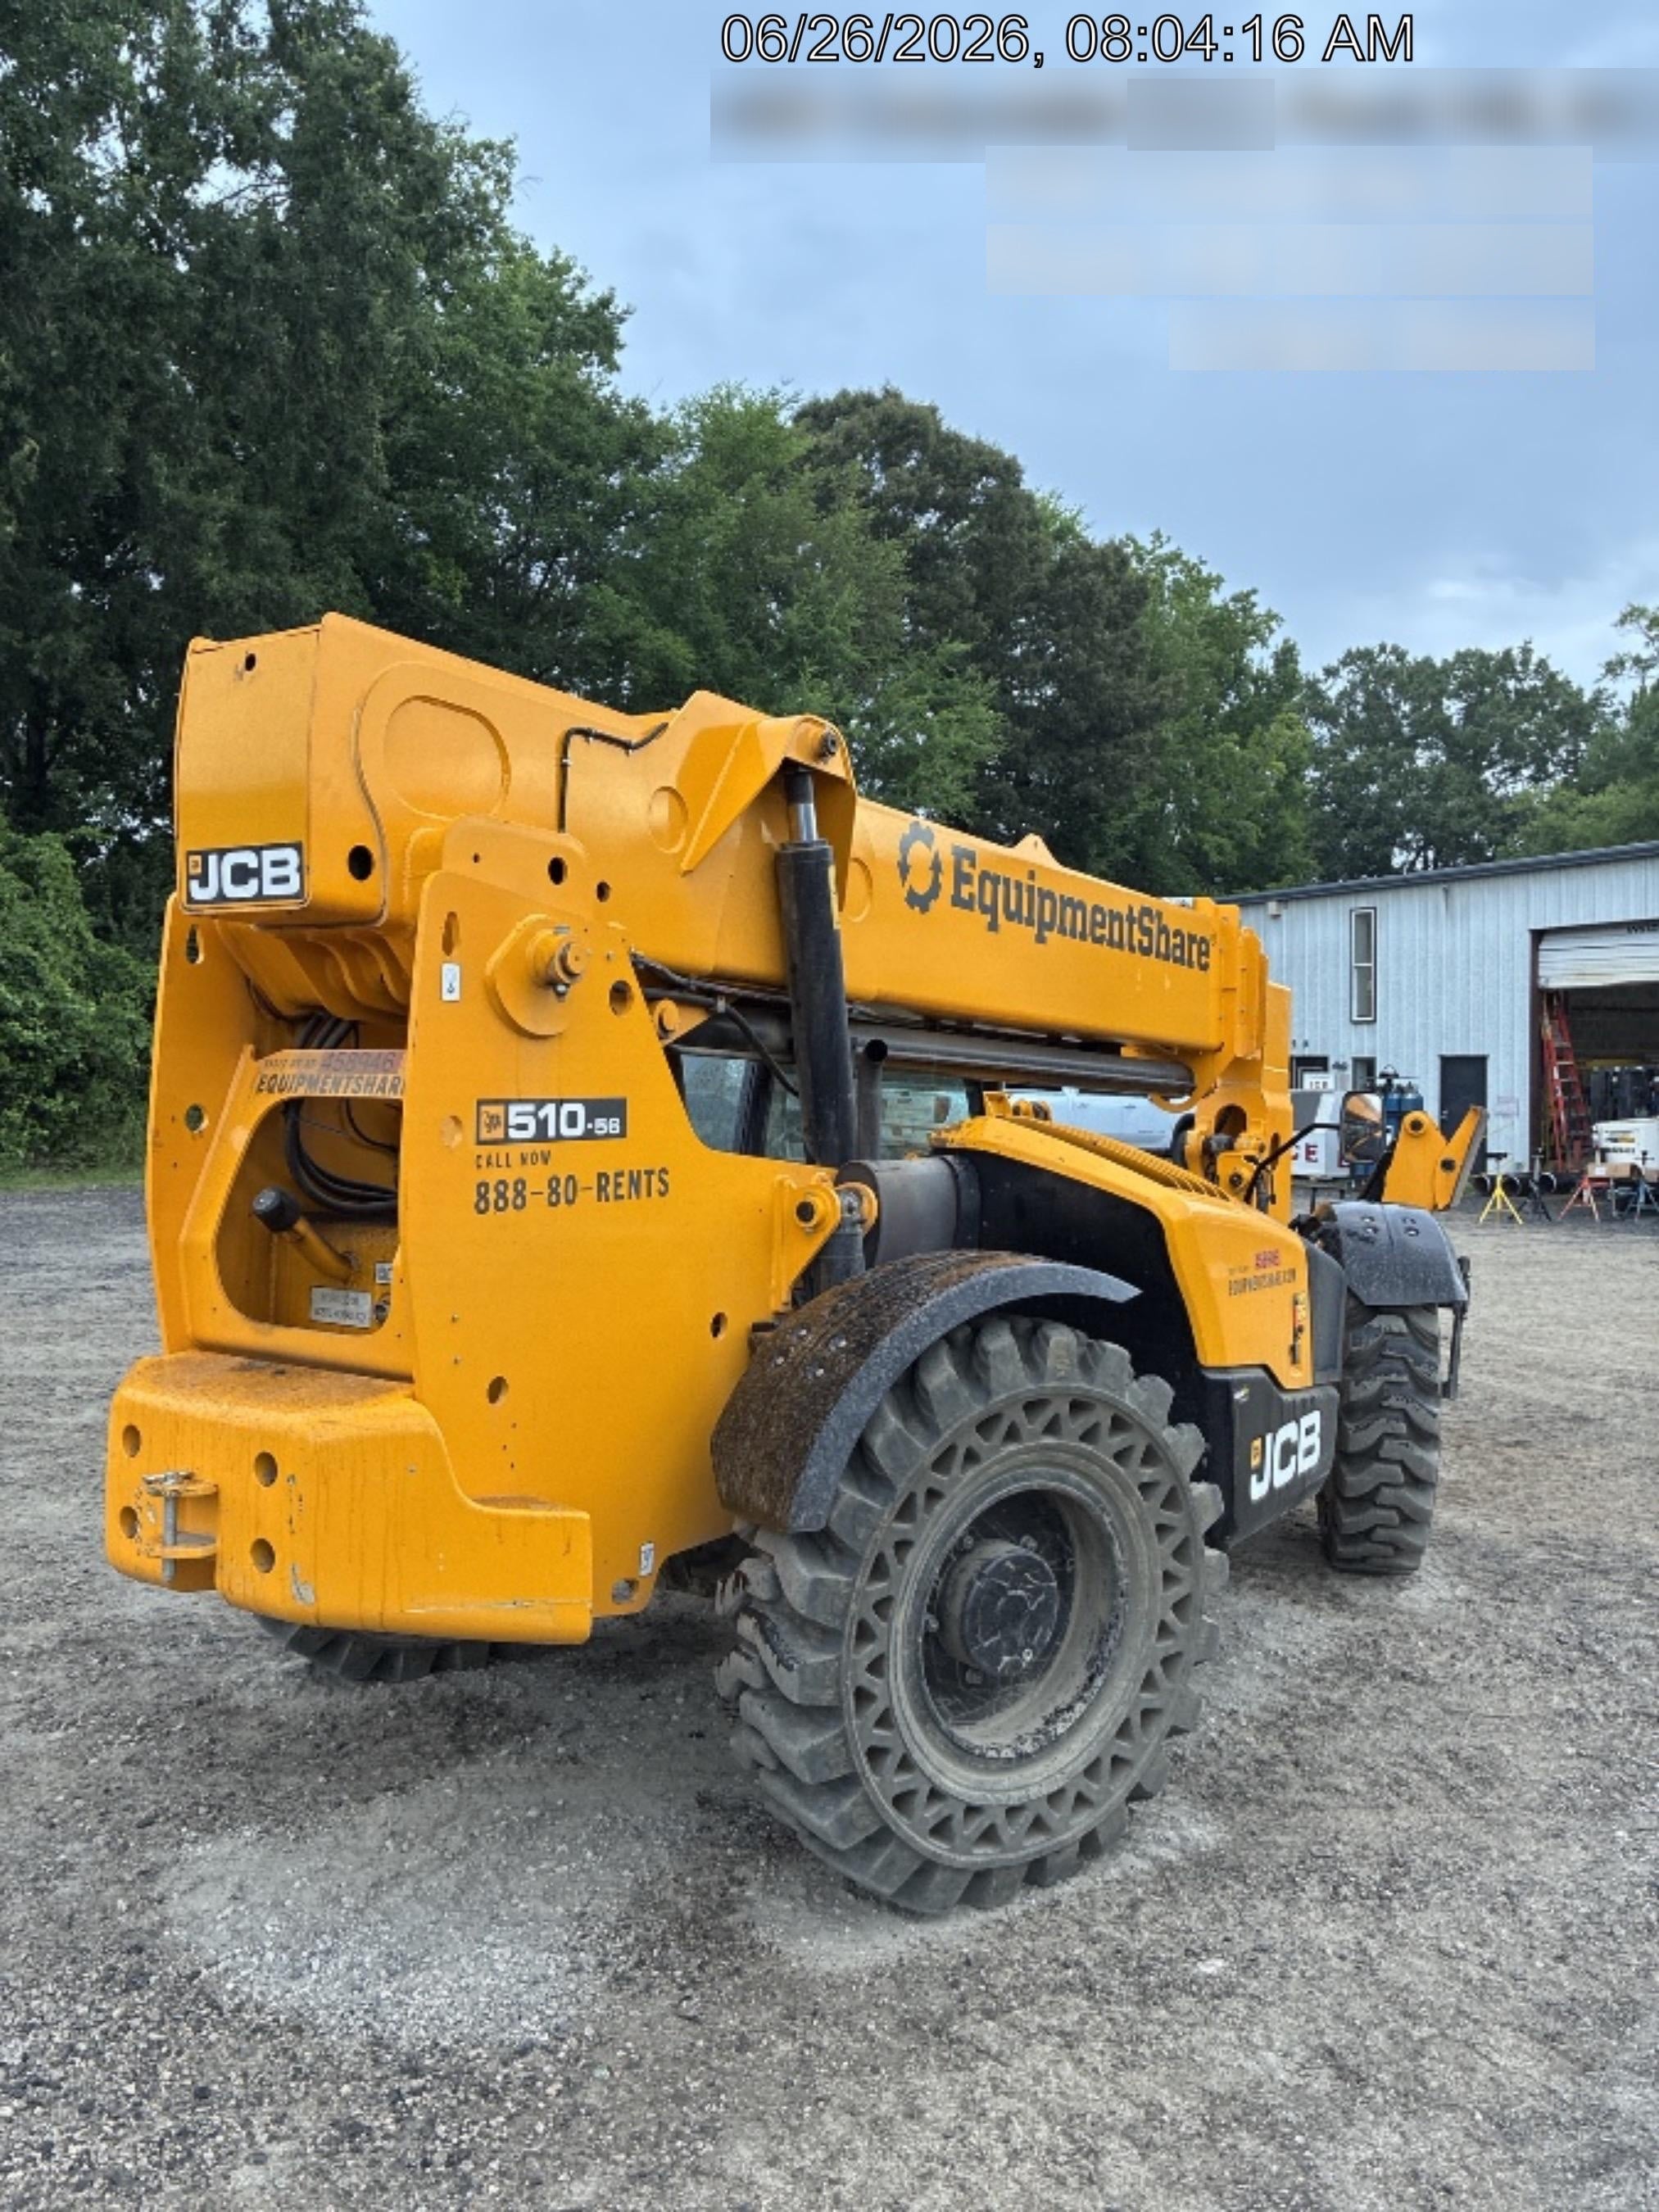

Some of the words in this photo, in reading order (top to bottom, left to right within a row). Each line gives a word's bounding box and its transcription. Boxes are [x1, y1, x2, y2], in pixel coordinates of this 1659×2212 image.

[189, 847, 301, 900] JCB
[950, 845, 1210, 972] EquipmentShare
[476, 1152, 512, 1170] CALL
[520, 1149, 551, 1167] NOW
[474, 1167, 669, 1215] 888-80-RENTS
[1250, 1410, 1321, 1501] JCB
